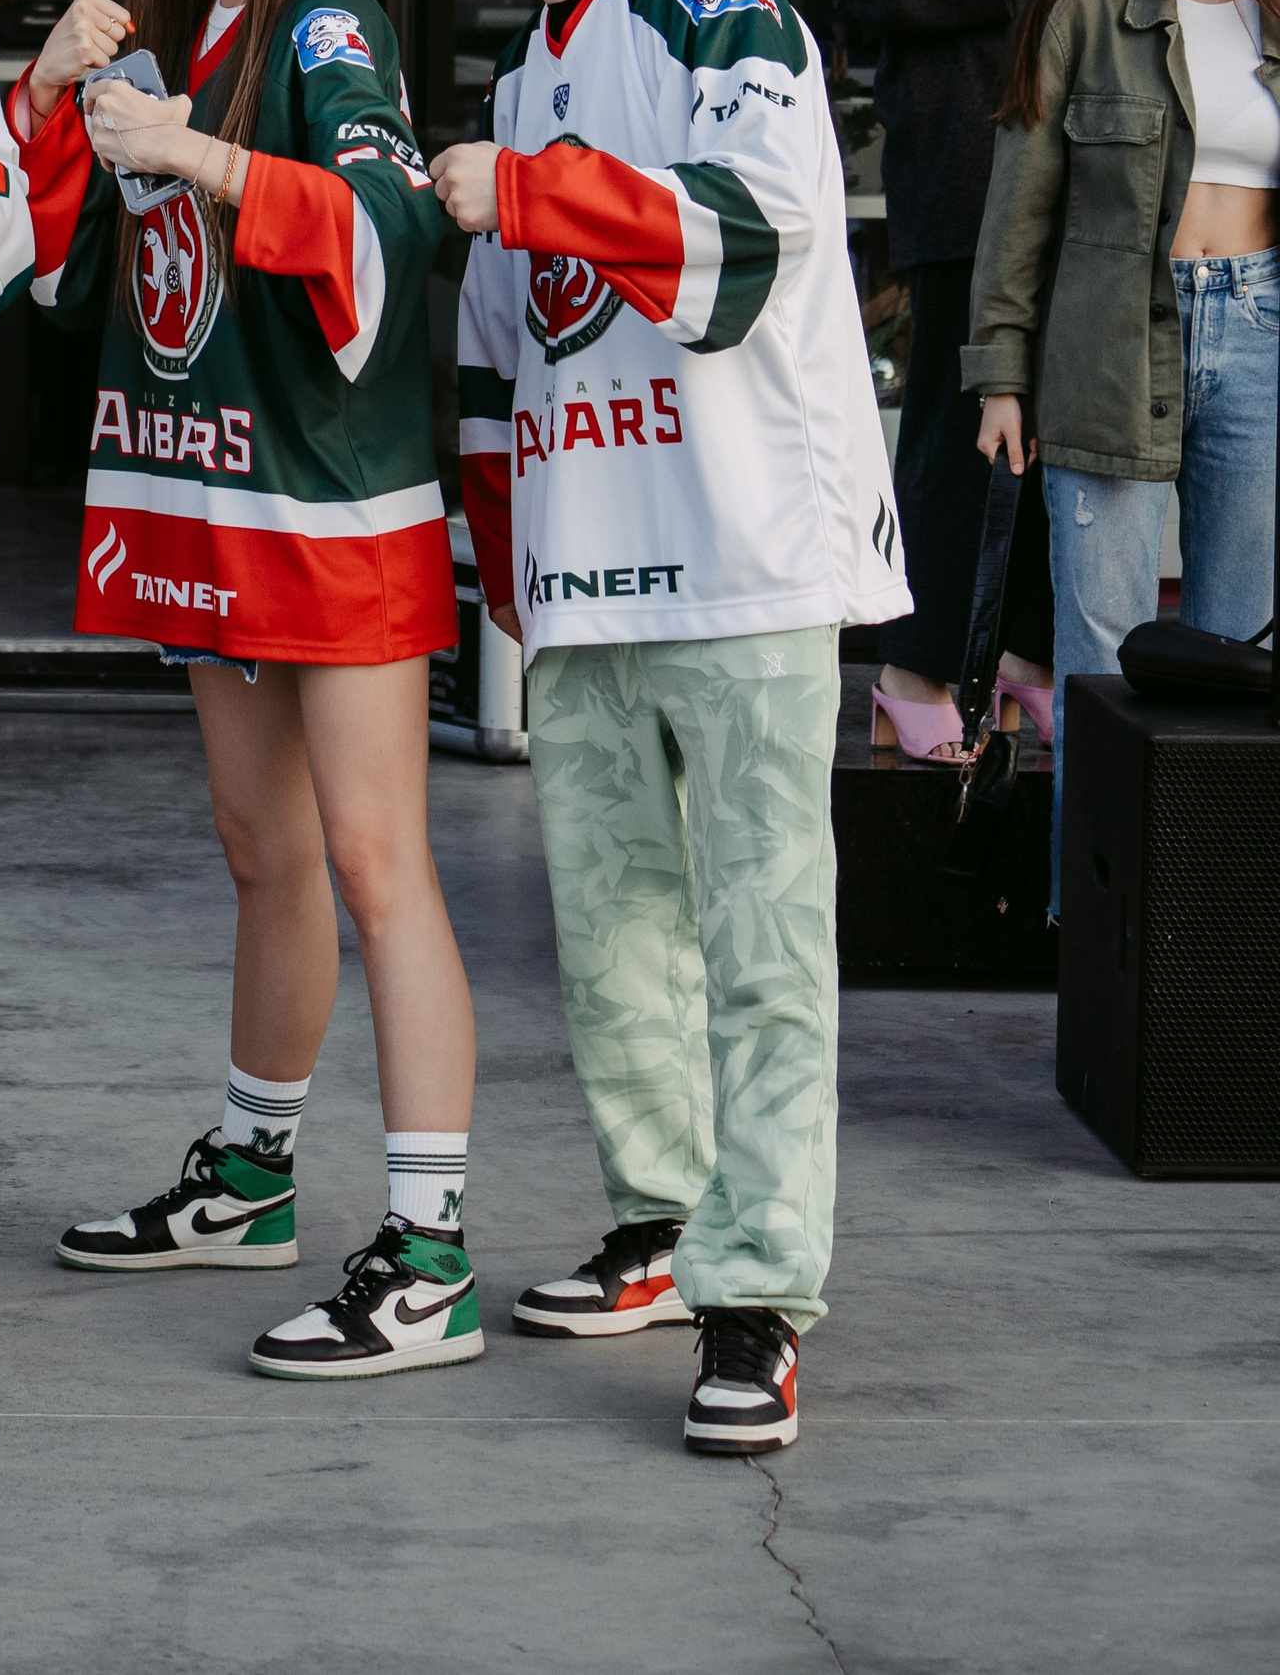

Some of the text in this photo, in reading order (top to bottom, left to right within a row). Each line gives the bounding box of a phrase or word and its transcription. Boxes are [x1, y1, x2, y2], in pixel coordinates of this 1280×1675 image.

[337, 123, 428, 176] TATNEF
[548, 378, 683, 454] ARS
[131, 572, 238, 617] TATNET
